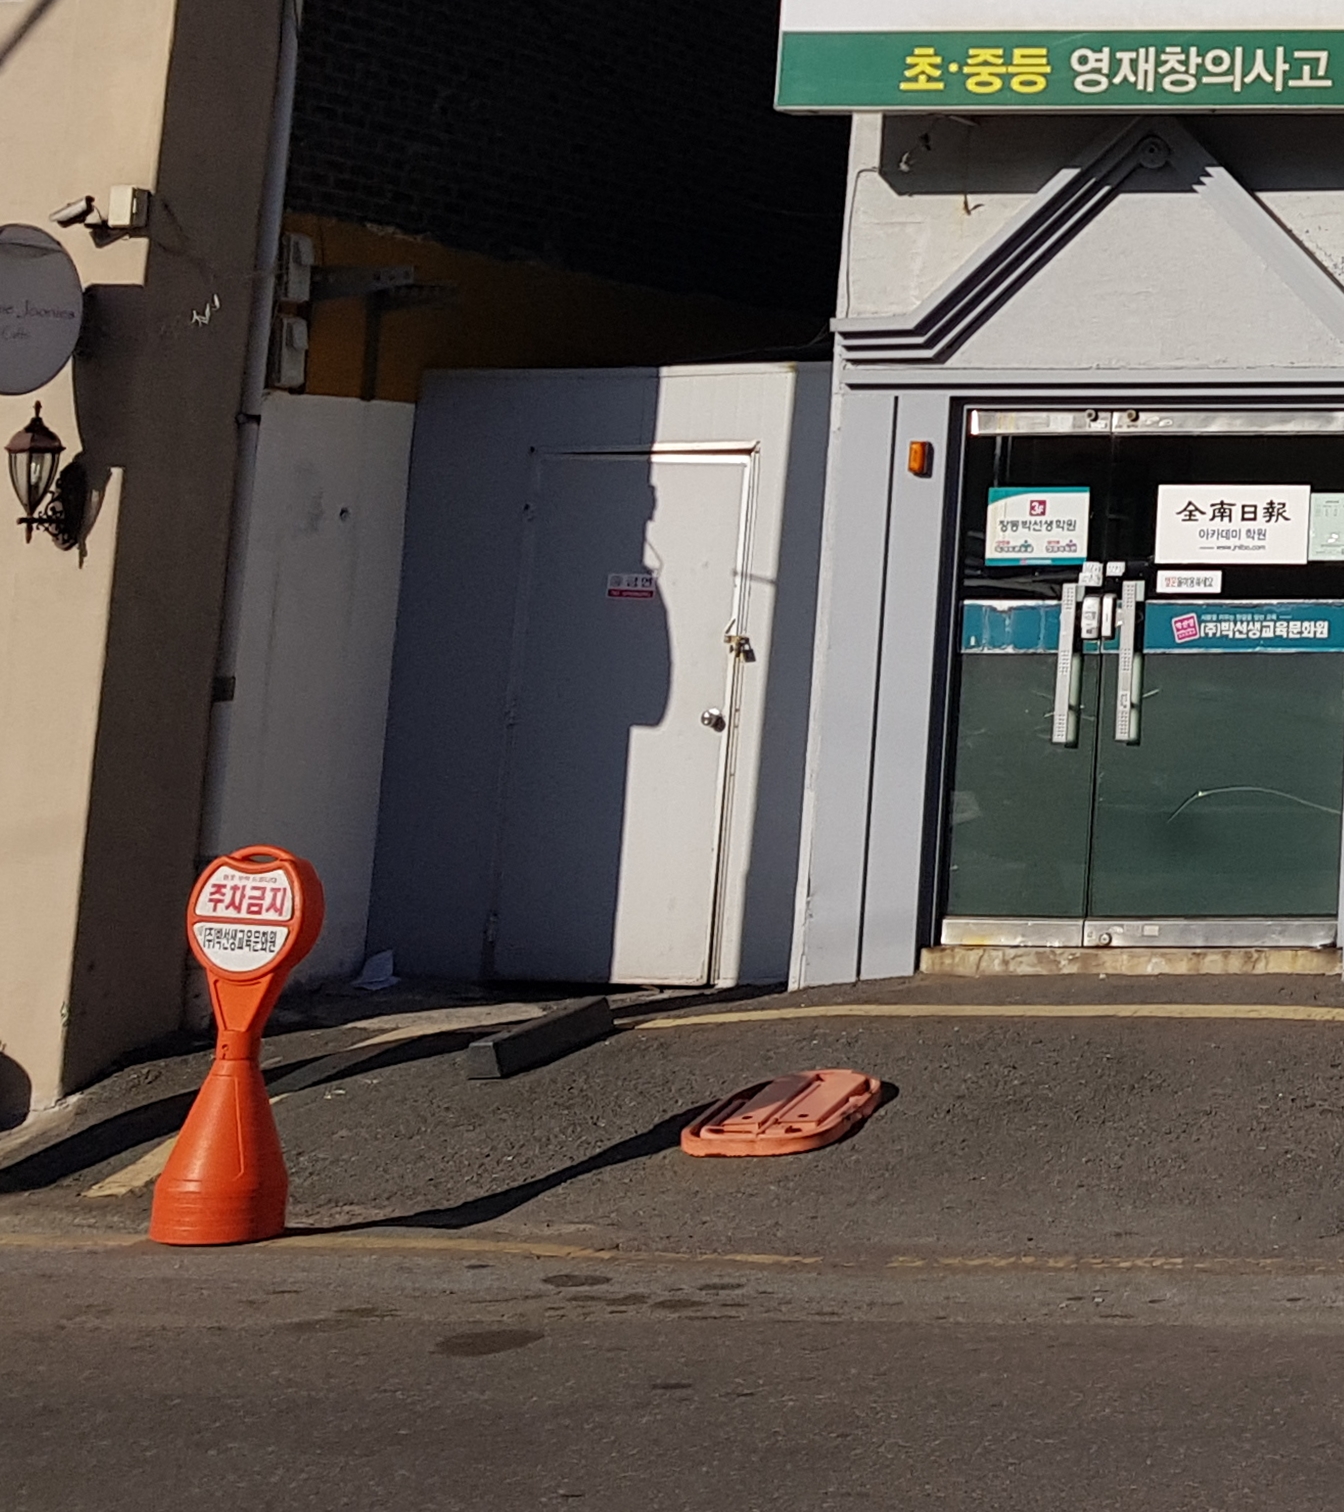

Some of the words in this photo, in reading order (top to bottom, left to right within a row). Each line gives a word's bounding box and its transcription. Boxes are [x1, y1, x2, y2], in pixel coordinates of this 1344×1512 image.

[898, 47, 1051, 94] 초·중등
[1069, 47, 1332, 93] 영재창의사고
[1031, 501, 1044, 514] 3F
[1176, 500, 1291, 523] 全南日報
[1199, 529, 1241, 541] 아카데미
[1246, 529, 1267, 541] 학원
[1201, 621, 1328, 638] (주)박선생교육문화원
[208, 883, 287, 917] 주차금지
